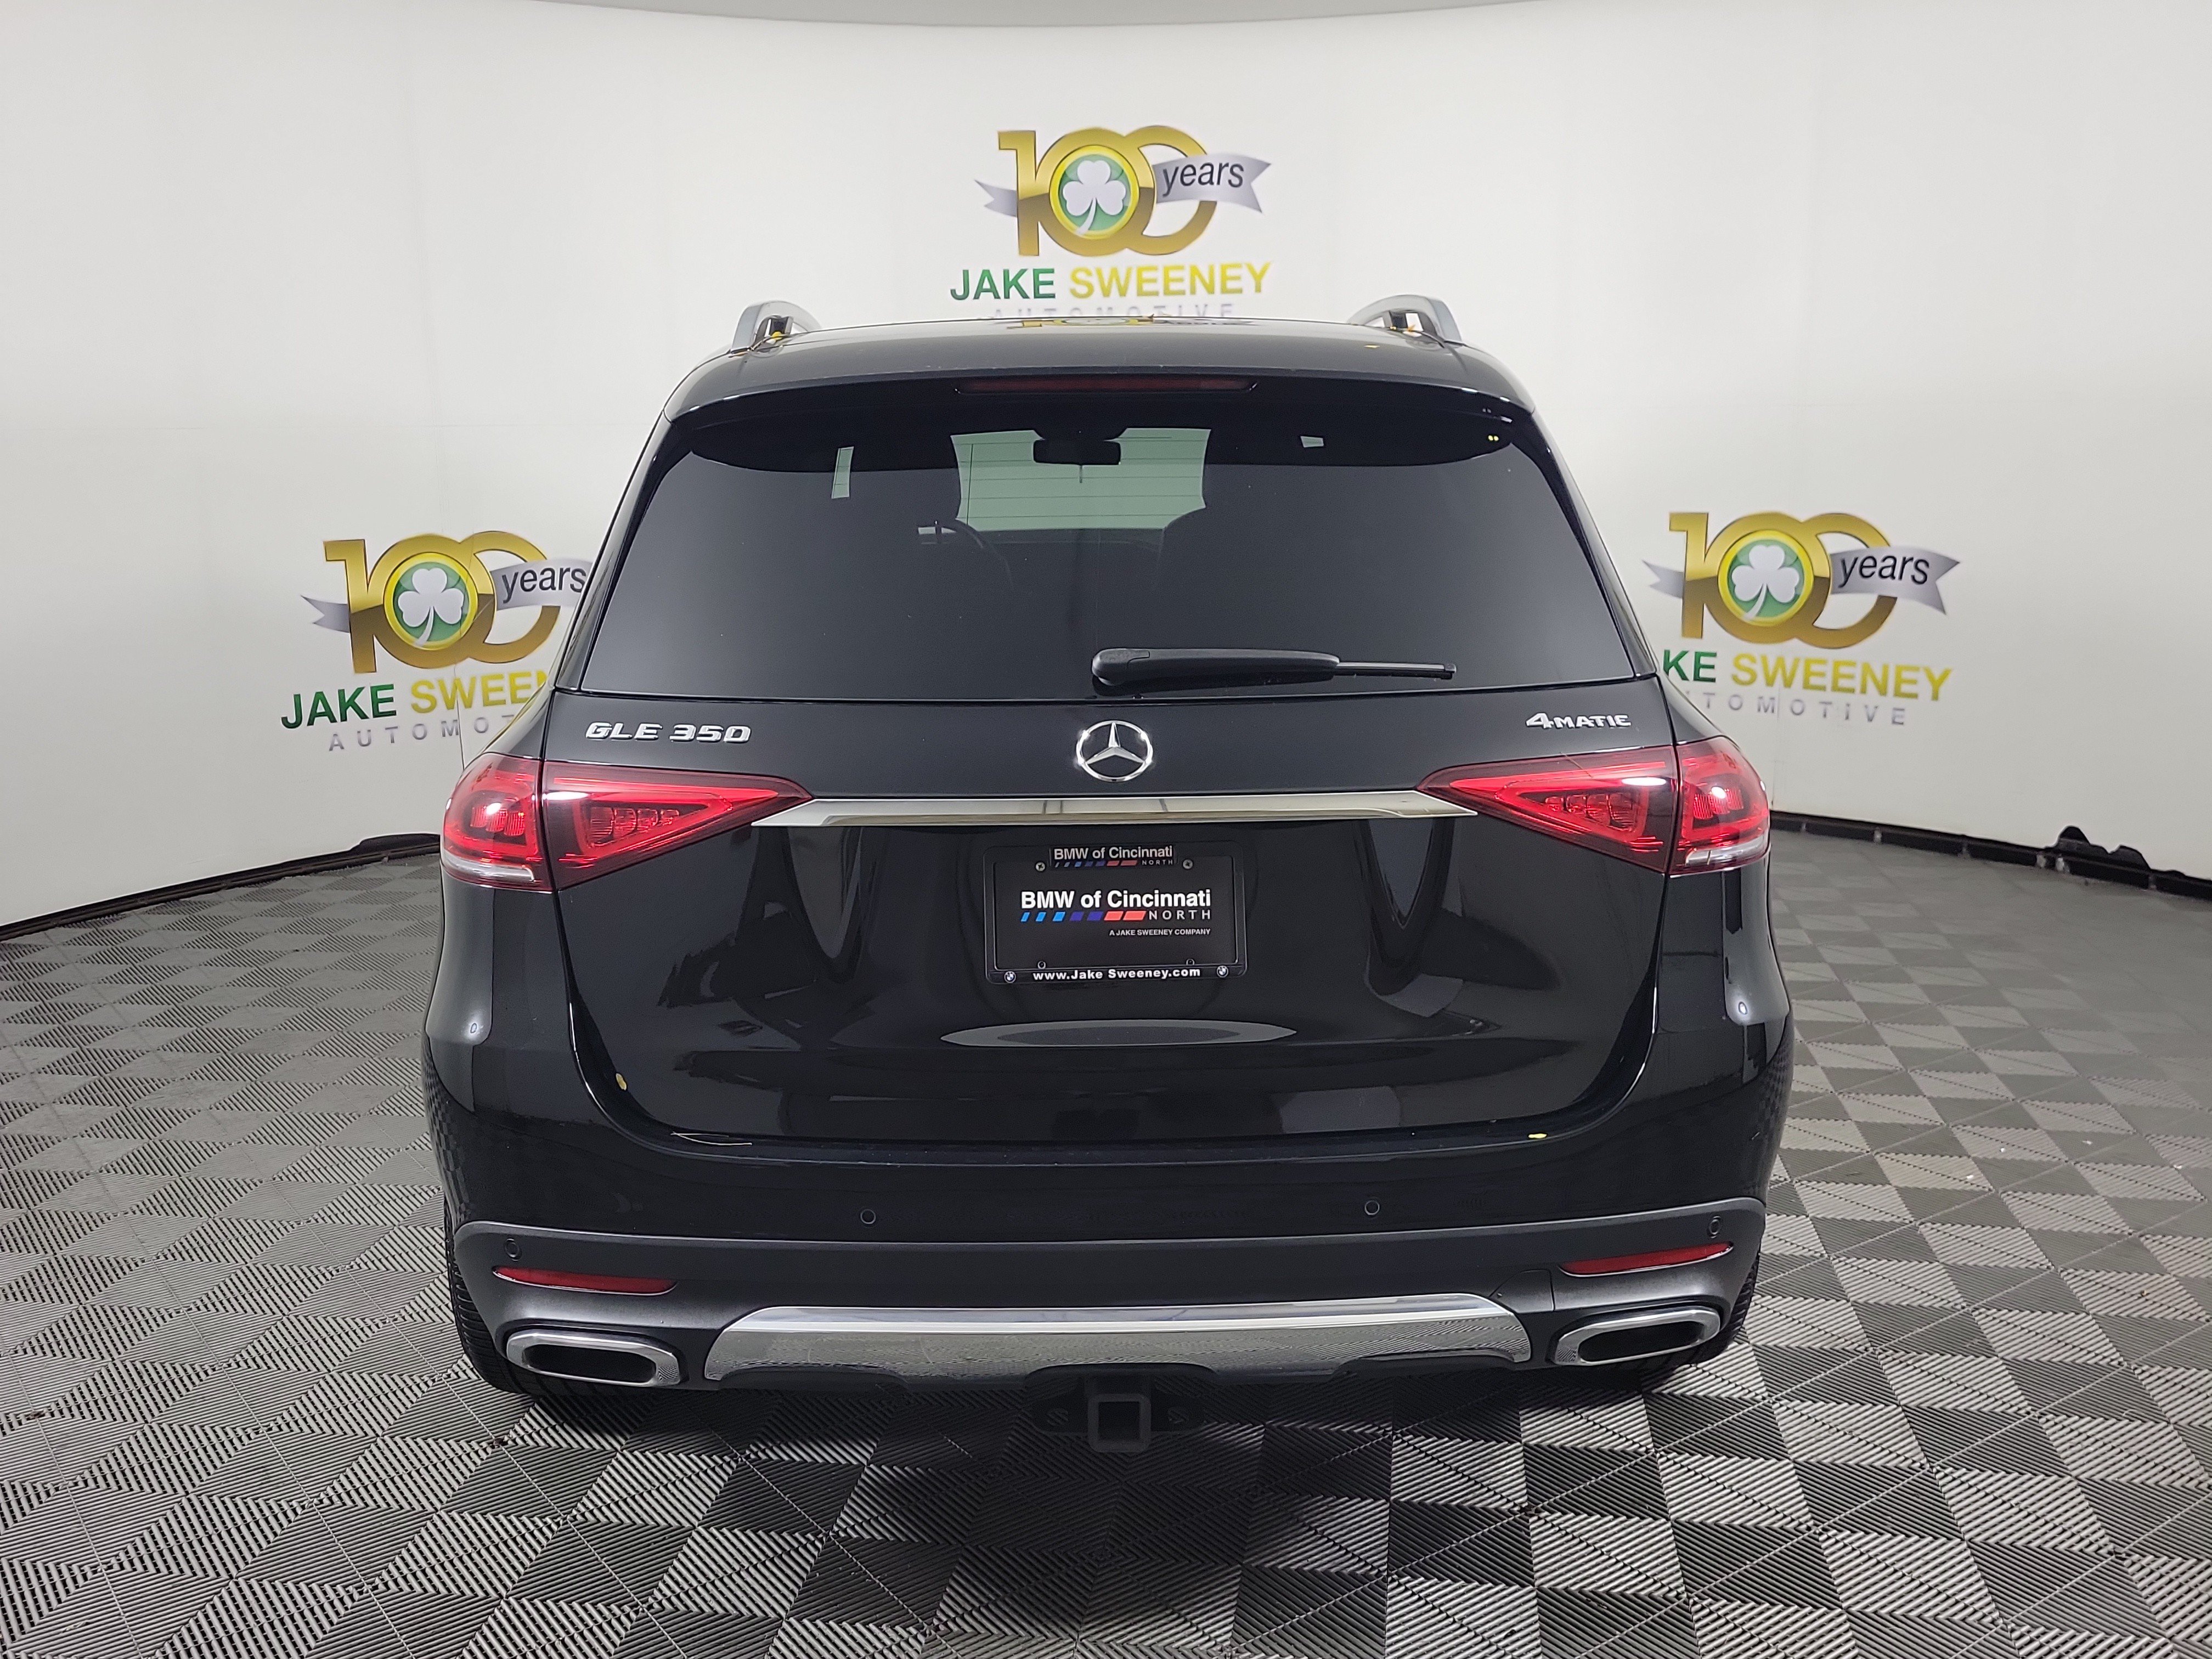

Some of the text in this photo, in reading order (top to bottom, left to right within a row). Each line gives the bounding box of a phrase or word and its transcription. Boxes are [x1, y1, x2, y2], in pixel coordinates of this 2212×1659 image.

[997, 125, 1244, 257] 100 years
[950, 262, 1273, 301] JAKE SWEENEY
[1669, 512, 1929, 649] 100 years
[323, 530, 587, 674] 100 years
[1663, 649, 1954, 701] KE SWEENEY
[281, 670, 548, 729] JAKE SWEE
[1686, 690, 1905, 726] TOMOTIVE
[329, 714, 515, 752] AUTOMOT
[585, 721, 752, 743] GLE 350
[1053, 845, 1173, 860] BMW of Cincinnati
[1020, 889, 1211, 909] BMW of Cincinnati
[1148, 910, 1211, 921] NORTH
[1032, 968, 1201, 981] www.Jake Sweeney.com
